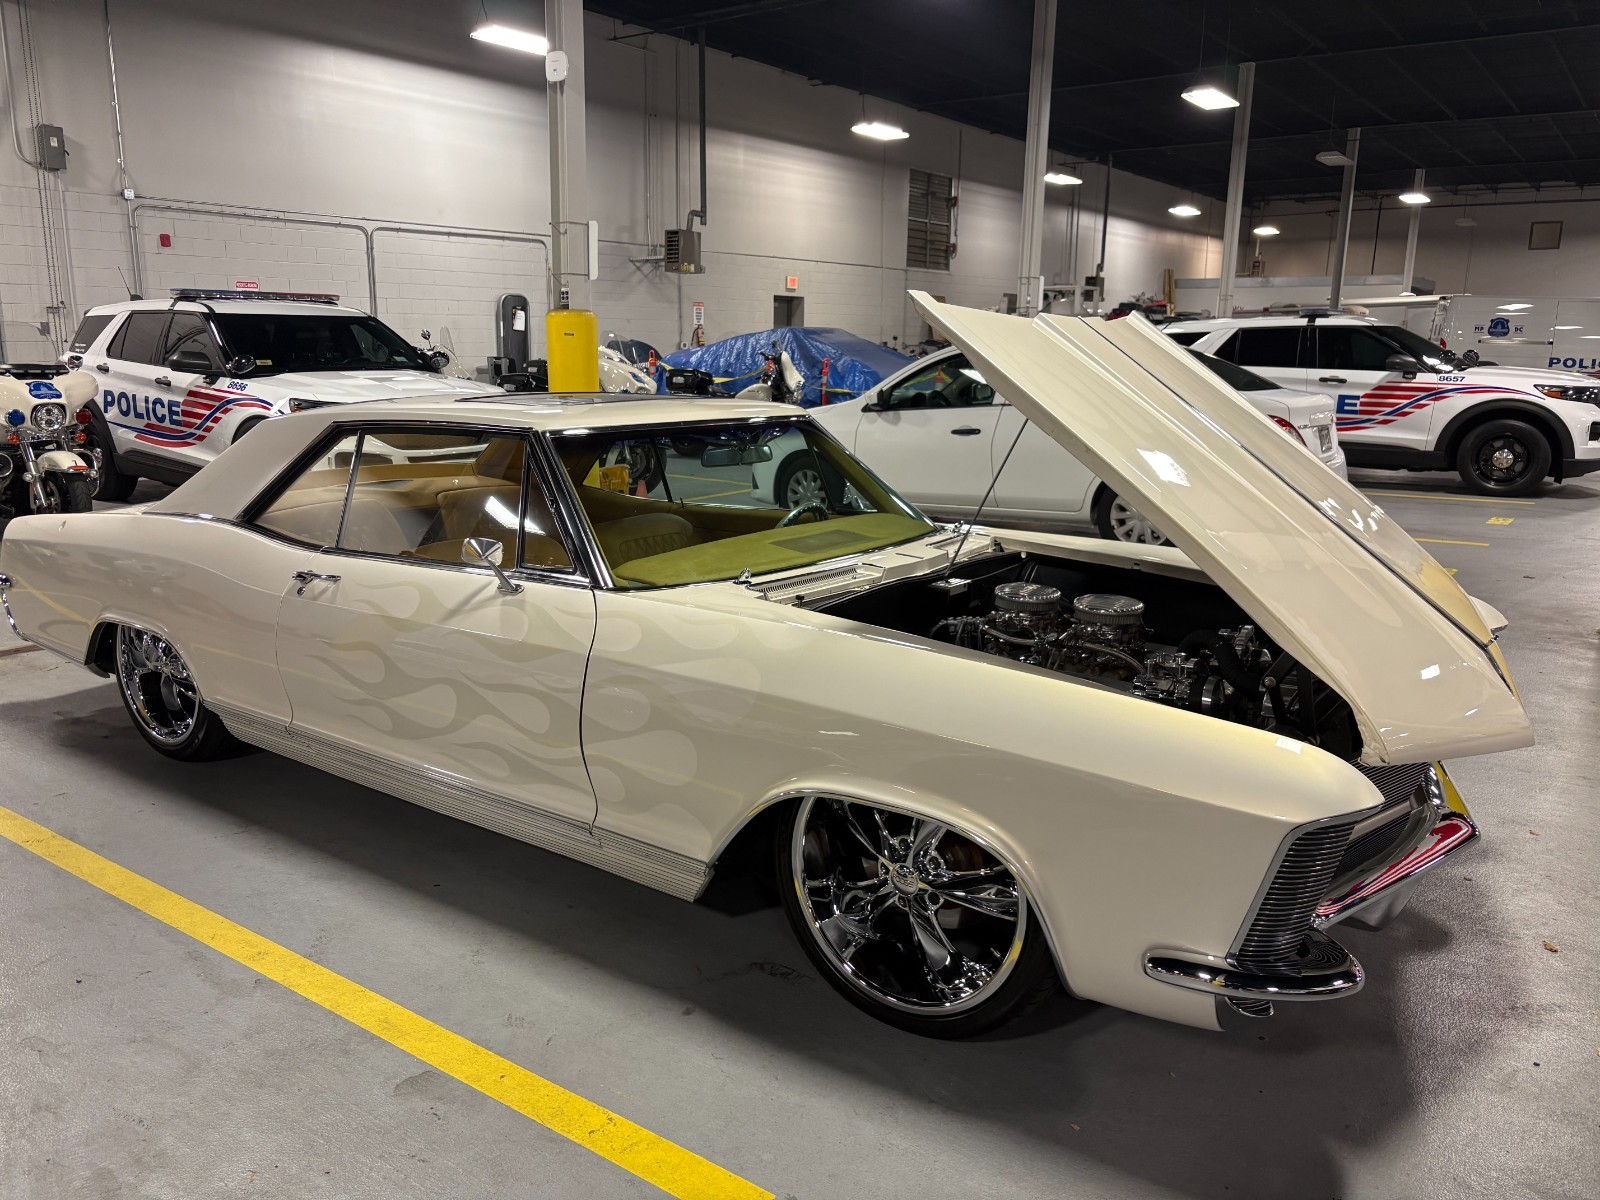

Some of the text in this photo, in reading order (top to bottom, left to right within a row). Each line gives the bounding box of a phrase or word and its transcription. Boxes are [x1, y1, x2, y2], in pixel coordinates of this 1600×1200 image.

[1548, 357, 1600, 369] POLI
[227, 381, 248, 391] 8656
[103, 389, 182, 426] POLICE
